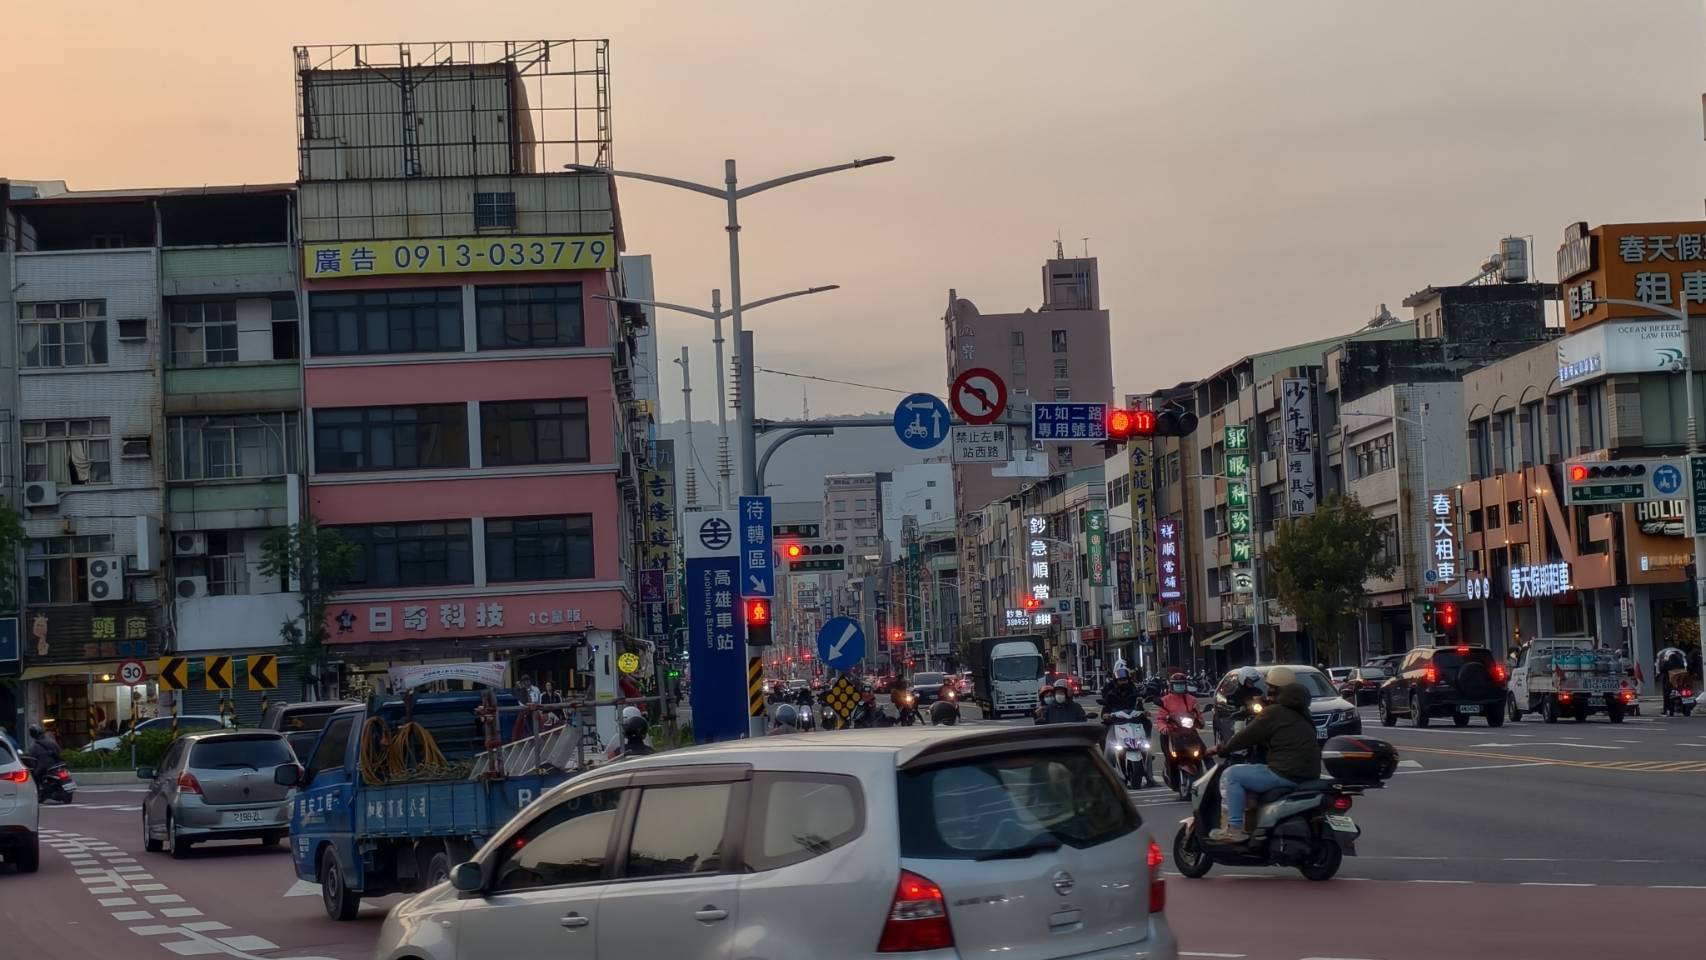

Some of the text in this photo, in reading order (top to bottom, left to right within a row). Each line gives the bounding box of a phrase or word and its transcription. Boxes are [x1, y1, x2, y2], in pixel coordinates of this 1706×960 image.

[314, 241, 606, 274] 廣告 0913-033779
[1619, 234, 1706, 263] 春天假
[1635, 269, 1706, 305] 租車
[1618, 324, 1681, 334] OCEAN BREEZE
[1037, 406, 1103, 421] 九如二路
[1037, 422, 1103, 438] 專用號誌
[956, 430, 1004, 443] 禁止左轉
[962, 445, 1000, 458] 站西路
[1227, 427, 1250, 559] 郭眼科診所
[746, 500, 767, 570] 待轉區
[1432, 493, 1455, 584] 春天租車
[1510, 561, 1570, 599] 春天假期租車
[704, 570, 714, 648] Kaohsiung Station
[714, 569, 734, 650] 高雄車站
[123, 667, 141, 679] 30
